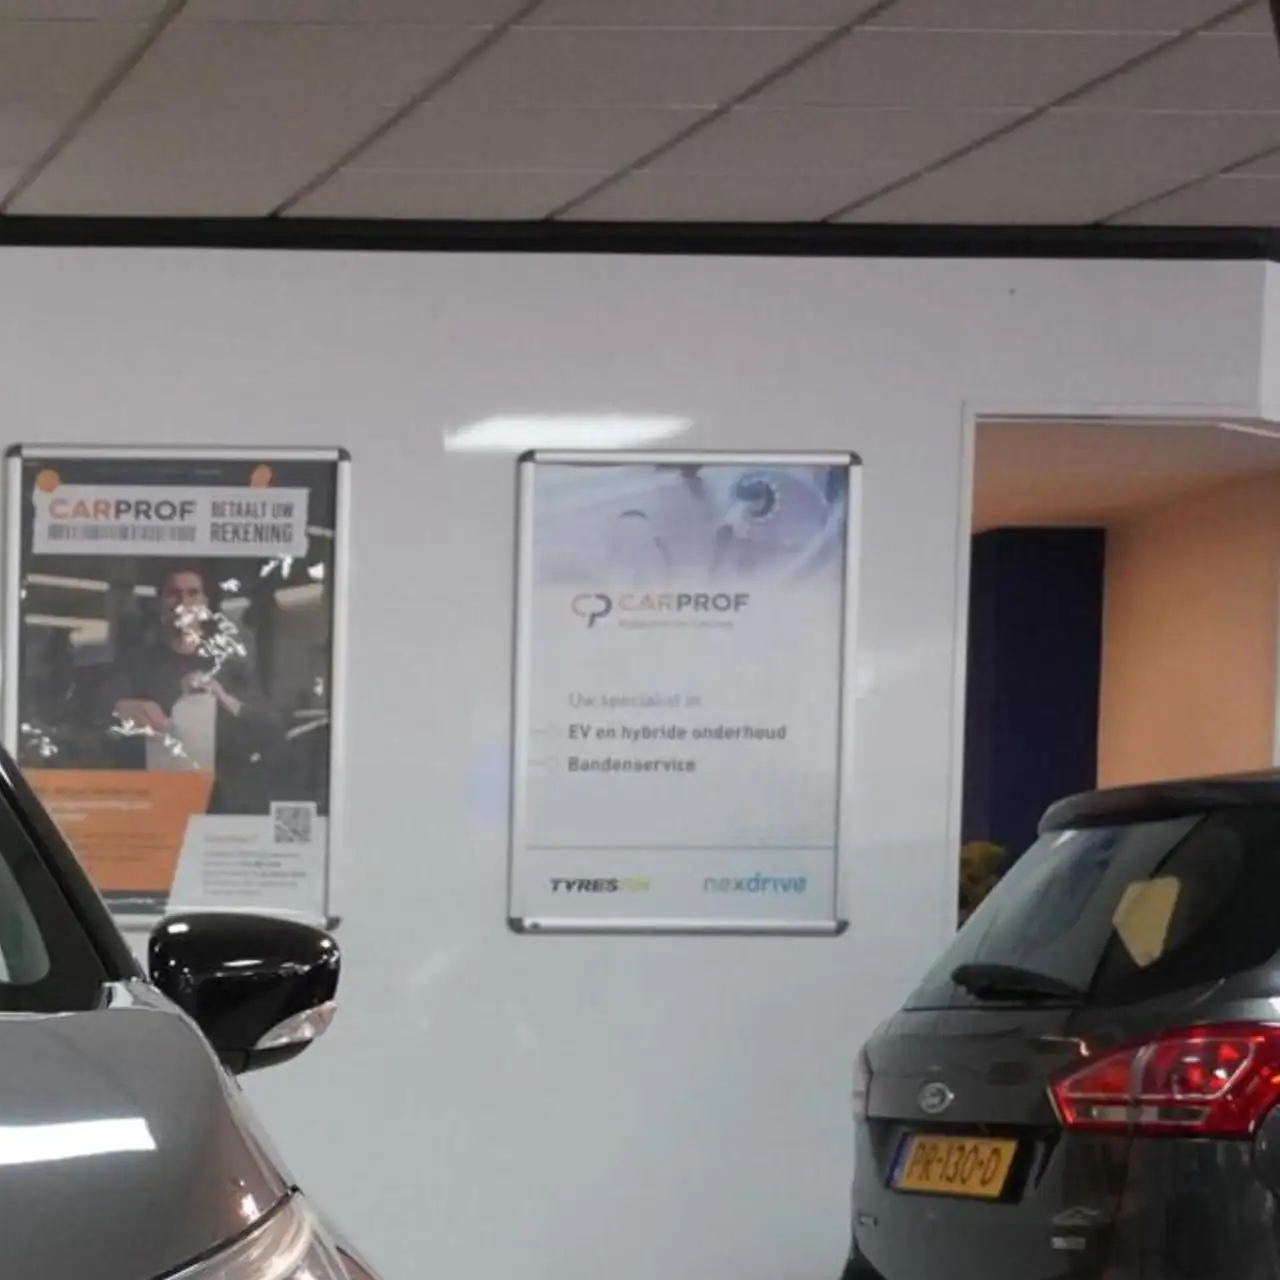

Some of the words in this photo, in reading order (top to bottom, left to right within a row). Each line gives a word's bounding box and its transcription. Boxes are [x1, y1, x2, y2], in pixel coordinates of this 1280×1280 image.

[48, 498, 197, 521] CARPROF
[211, 500, 267, 518] BETAALT
[272, 502, 294, 518] UW
[210, 523, 294, 543] REKENING
[618, 592, 751, 613] CARPROF
[568, 692, 595, 708] Uw
[601, 691, 680, 710] specialist
[685, 692, 702, 707] in
[568, 724, 591, 740] EV
[596, 727, 615, 740] en
[621, 724, 687, 743] hybride
[692, 724, 788, 741] onderhoud
[568, 756, 696, 773] Bandenservice
[703, 871, 808, 894] nexdrive
